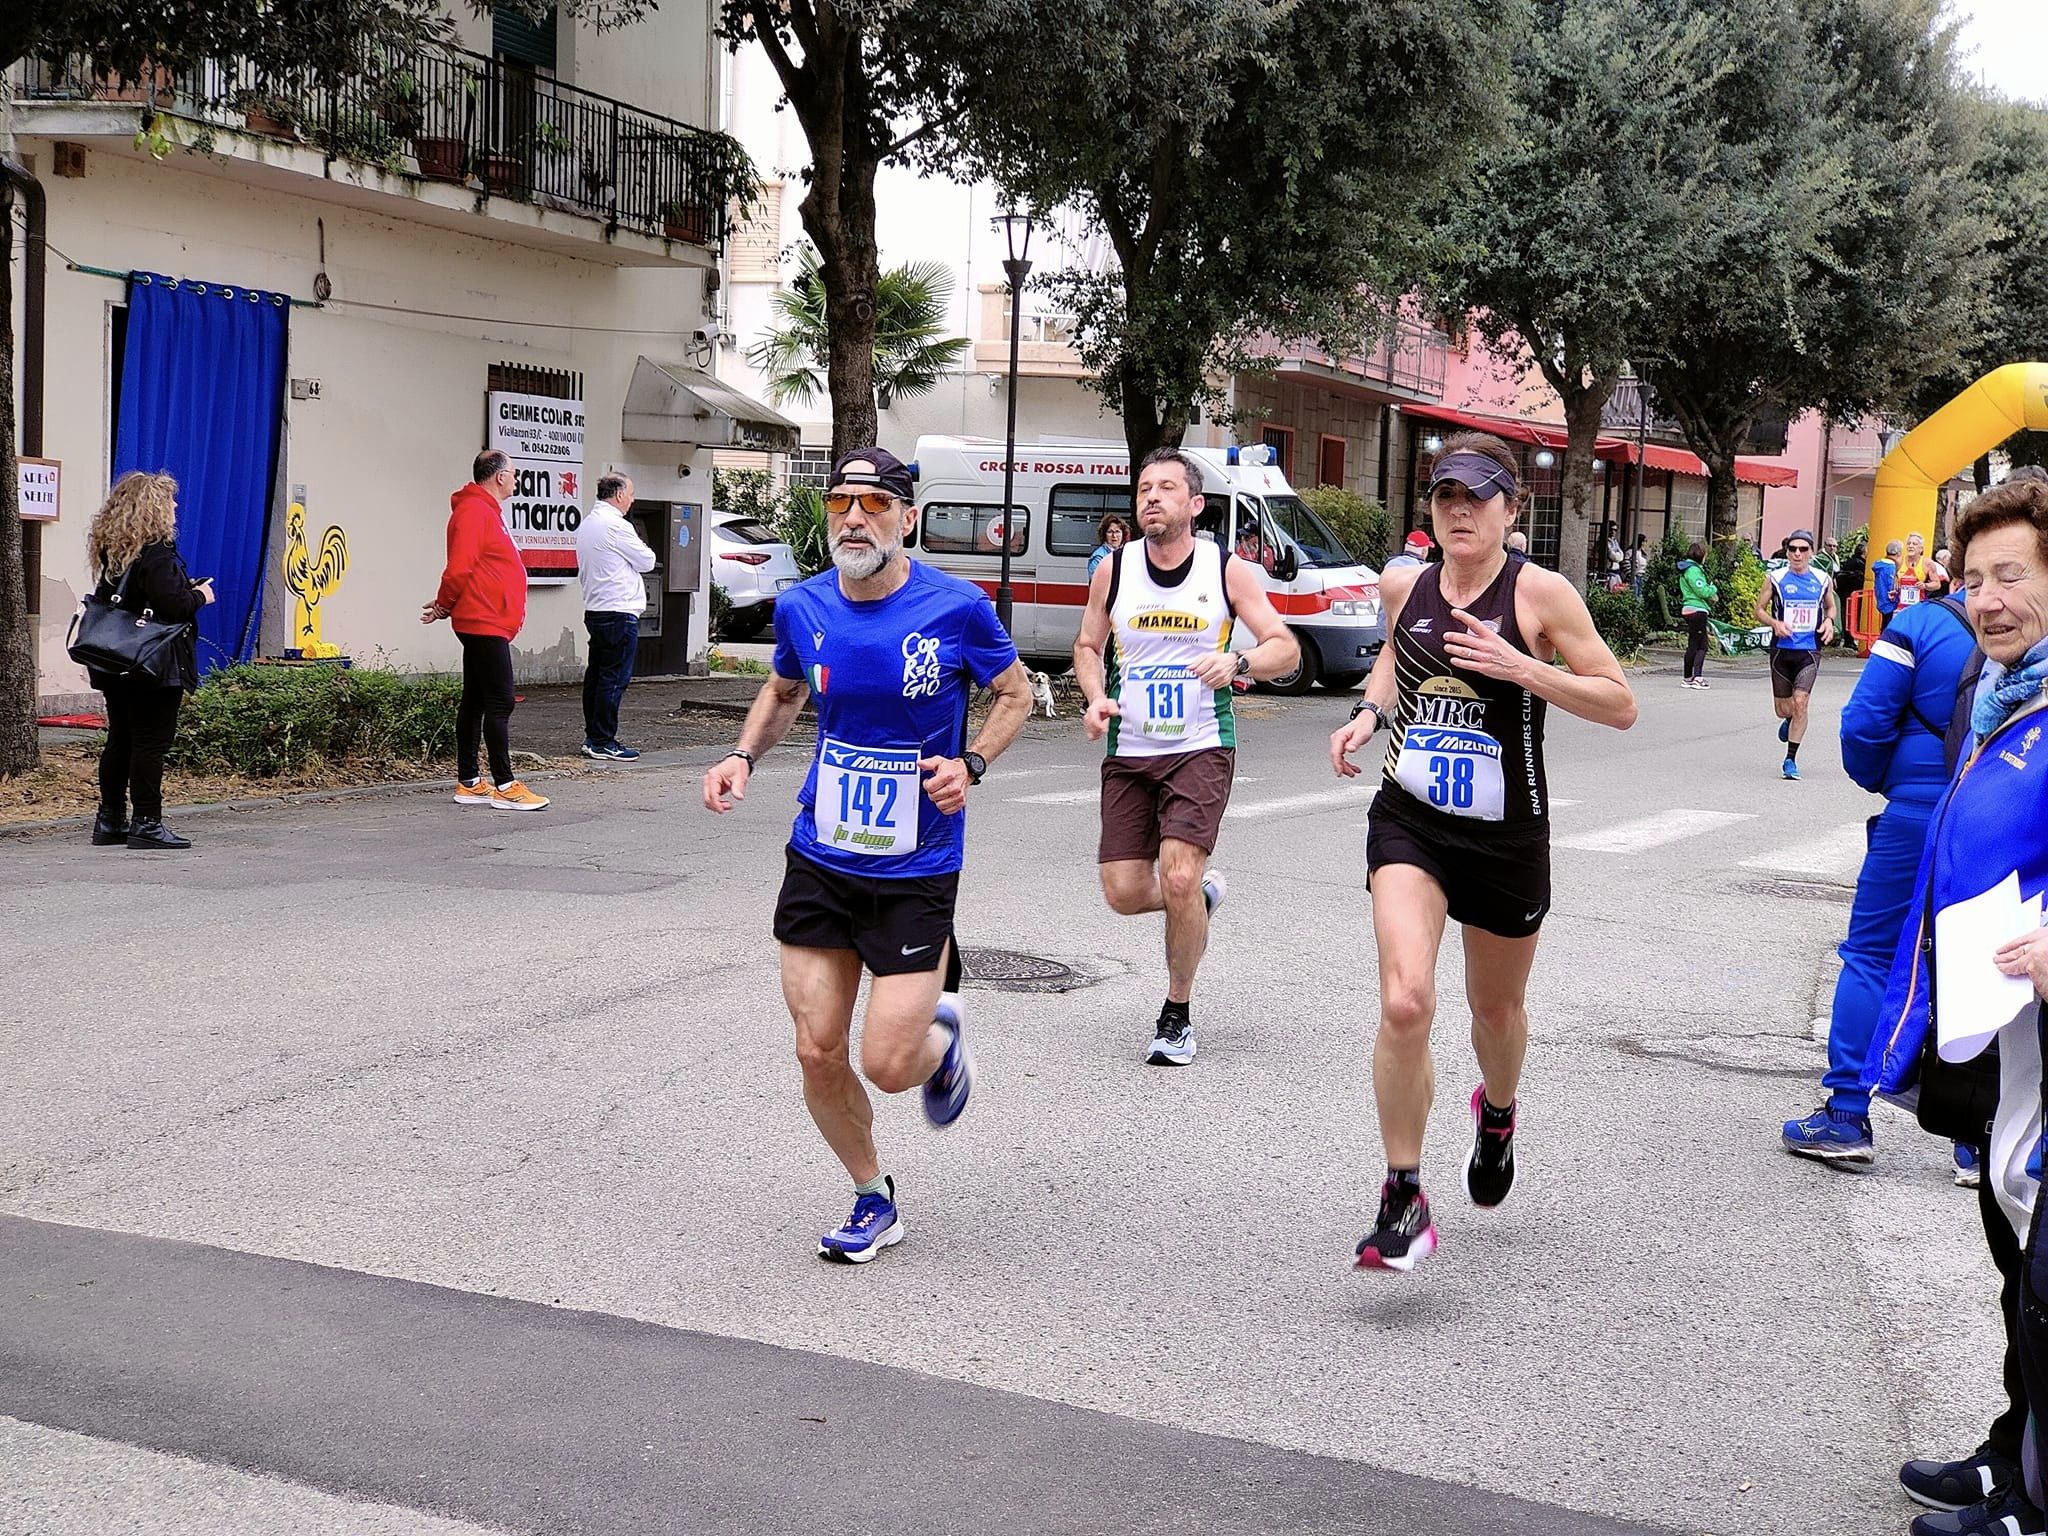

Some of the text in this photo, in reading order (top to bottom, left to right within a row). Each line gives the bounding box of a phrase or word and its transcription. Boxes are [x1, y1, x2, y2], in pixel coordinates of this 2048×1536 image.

[309, 382, 319, 395] 68
[513, 468, 551, 498] san
[1034, 463, 1084, 474] ROSSA
[512, 502, 581, 532] marco
[1137, 615, 1198, 630] MAMELI
[1793, 608, 1811, 624] 261
[1146, 683, 1184, 719] 131
[1434, 685, 1462, 694] since 2015
[1414, 693, 1486, 729] MRC
[1523, 689, 1532, 721] CLUB
[1523, 724, 1537, 787] RUNNERS
[1428, 756, 1475, 808] 38
[838, 773, 898, 828] 142
